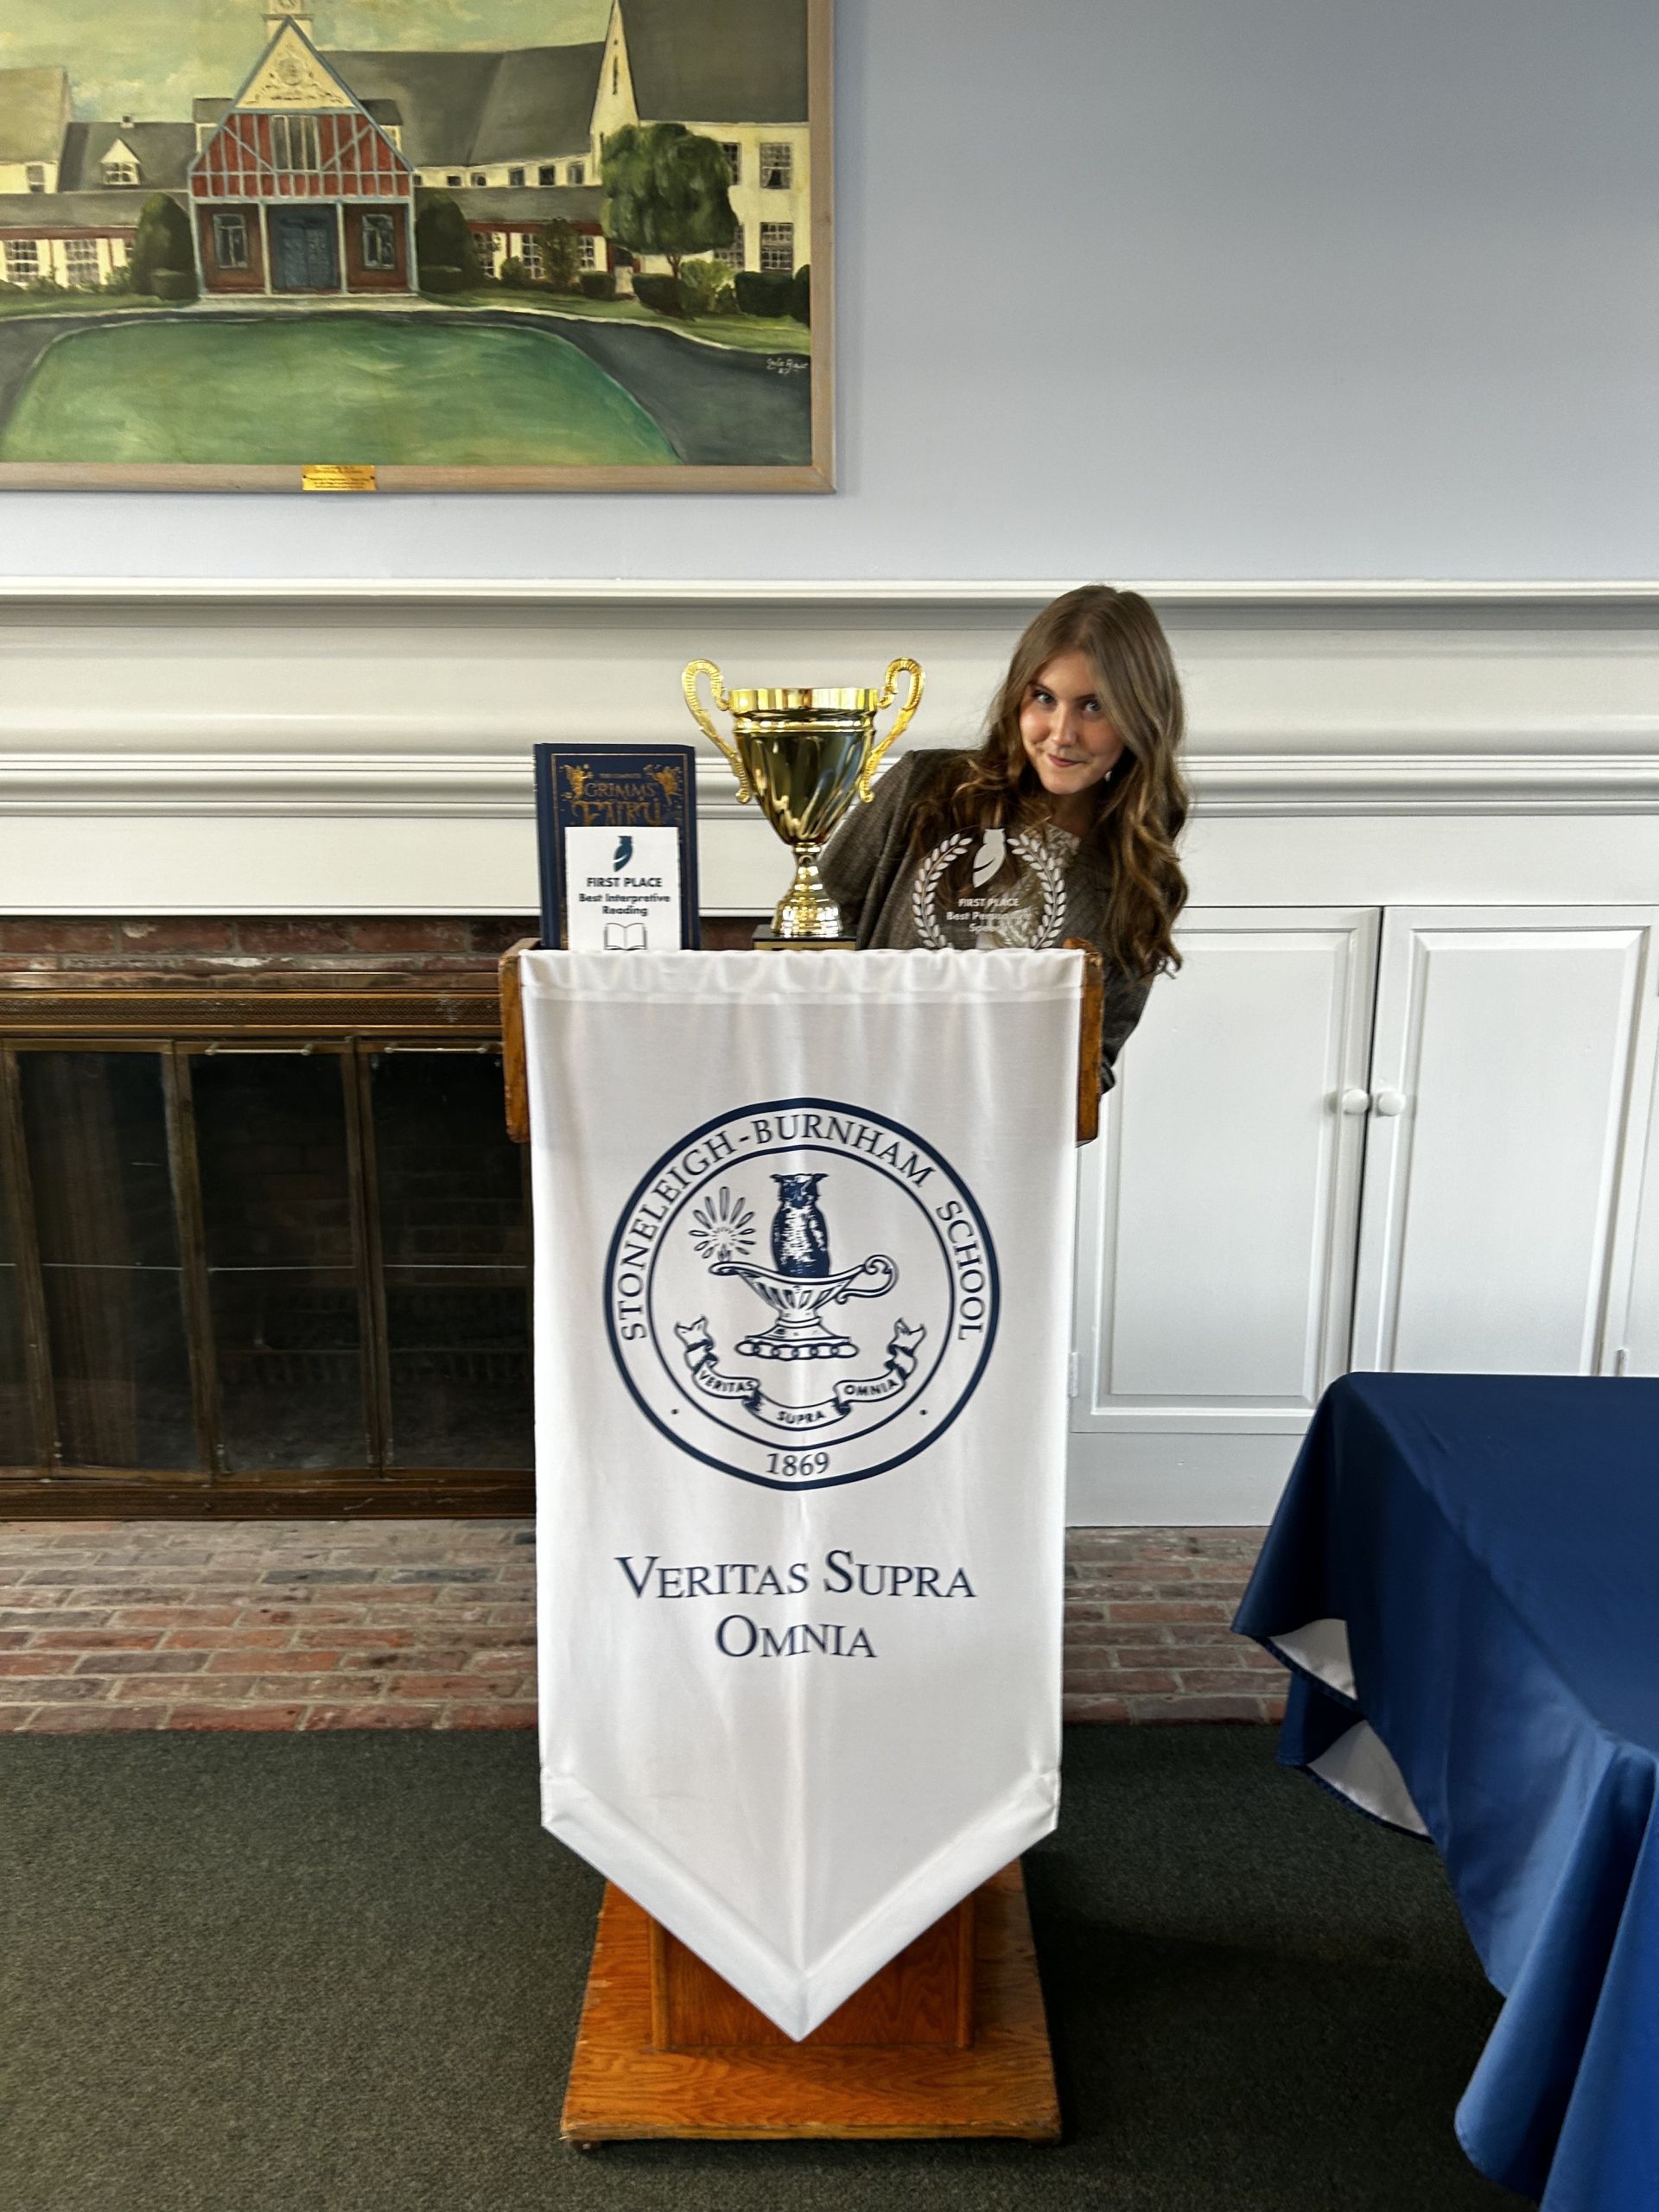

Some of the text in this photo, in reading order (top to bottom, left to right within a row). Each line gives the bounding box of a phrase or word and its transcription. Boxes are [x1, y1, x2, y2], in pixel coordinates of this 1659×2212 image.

[587, 877, 663, 887] FIRST PLACE
[579, 893, 671, 904] Best Interpretive
[957, 898, 1020, 907] FIRST PLACE
[602, 905, 648, 917] Reading
[946, 911, 970, 920] Best
[617, 1114, 986, 1341] STONELEIGH-BURNHAM SCHOOL
[698, 1370, 899, 1424] VERITAS SUPRA OMNIA
[766, 1452, 830, 1477] 1869
